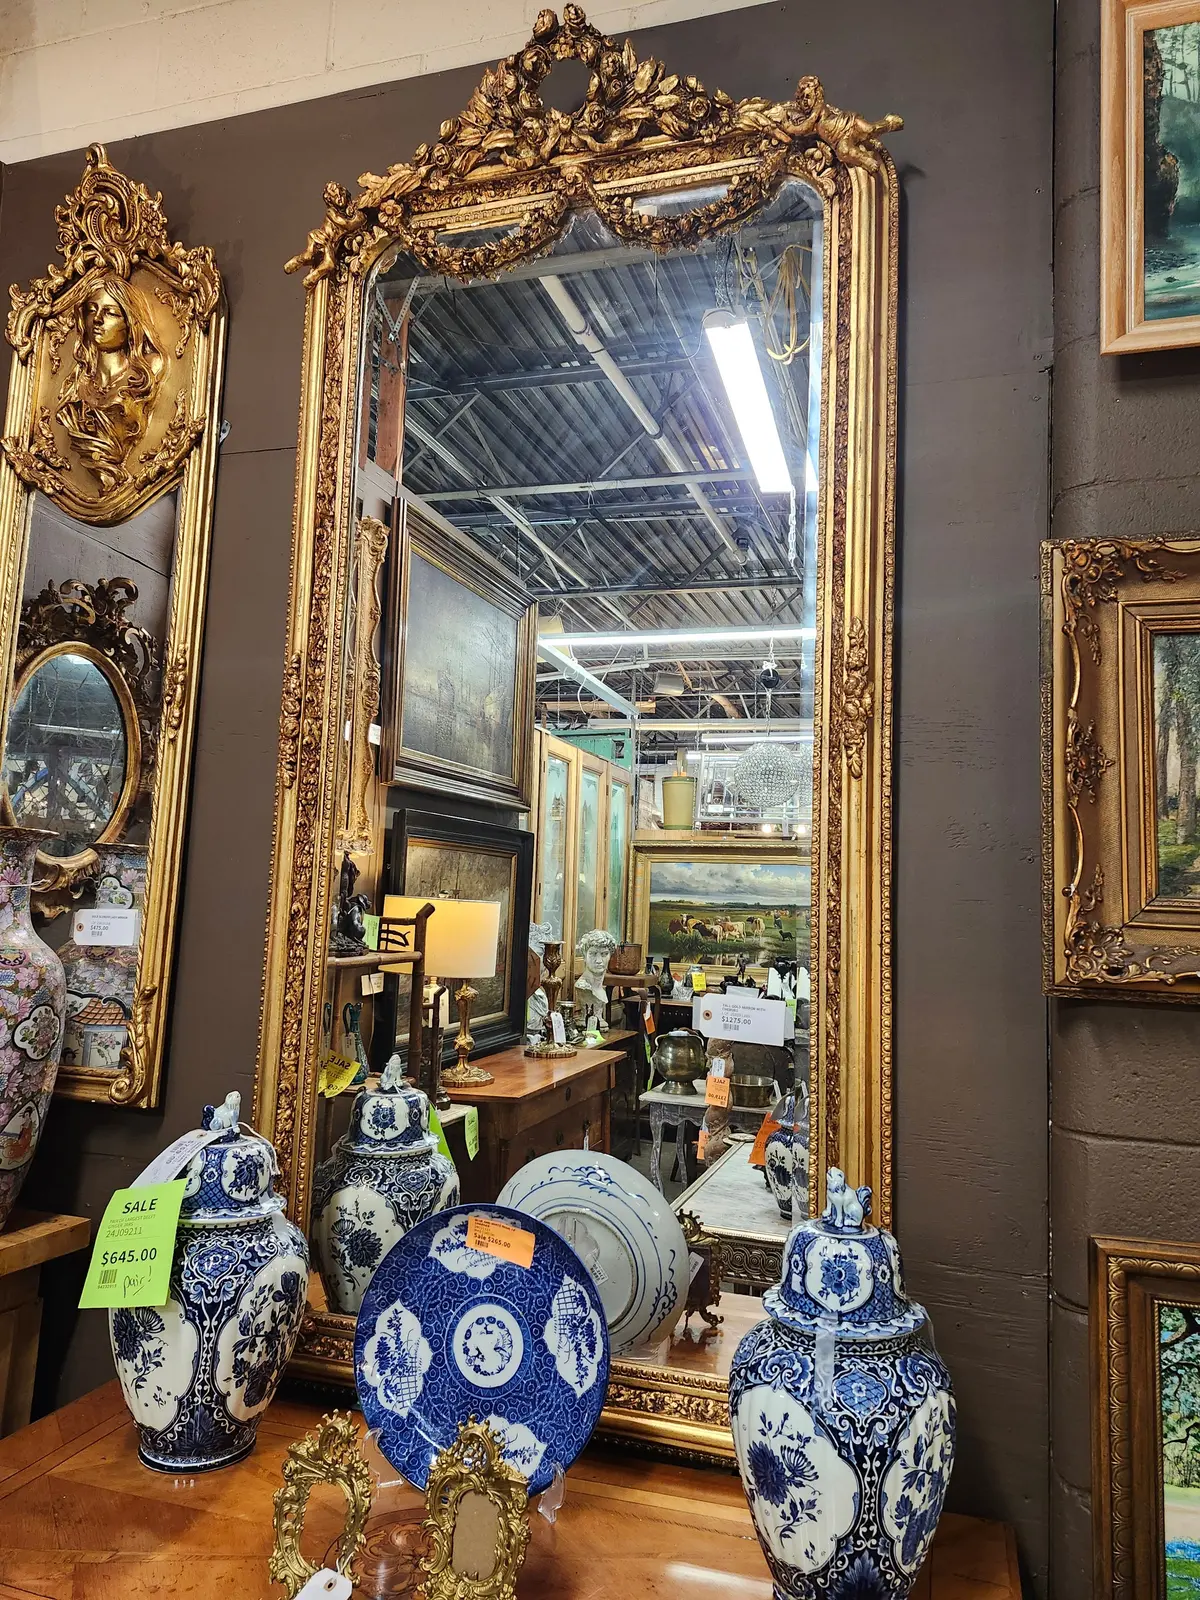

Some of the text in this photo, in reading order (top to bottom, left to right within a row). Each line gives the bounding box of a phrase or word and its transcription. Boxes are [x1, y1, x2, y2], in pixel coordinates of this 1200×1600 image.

[722, 1016, 752, 1025] $1275.00
[122, 1198, 158, 1214] SALE
[106, 1227, 142, 1238] 24J09211
[488, 1236, 511, 1248] $265.00
[101, 1248, 157, 1267] $645.00
